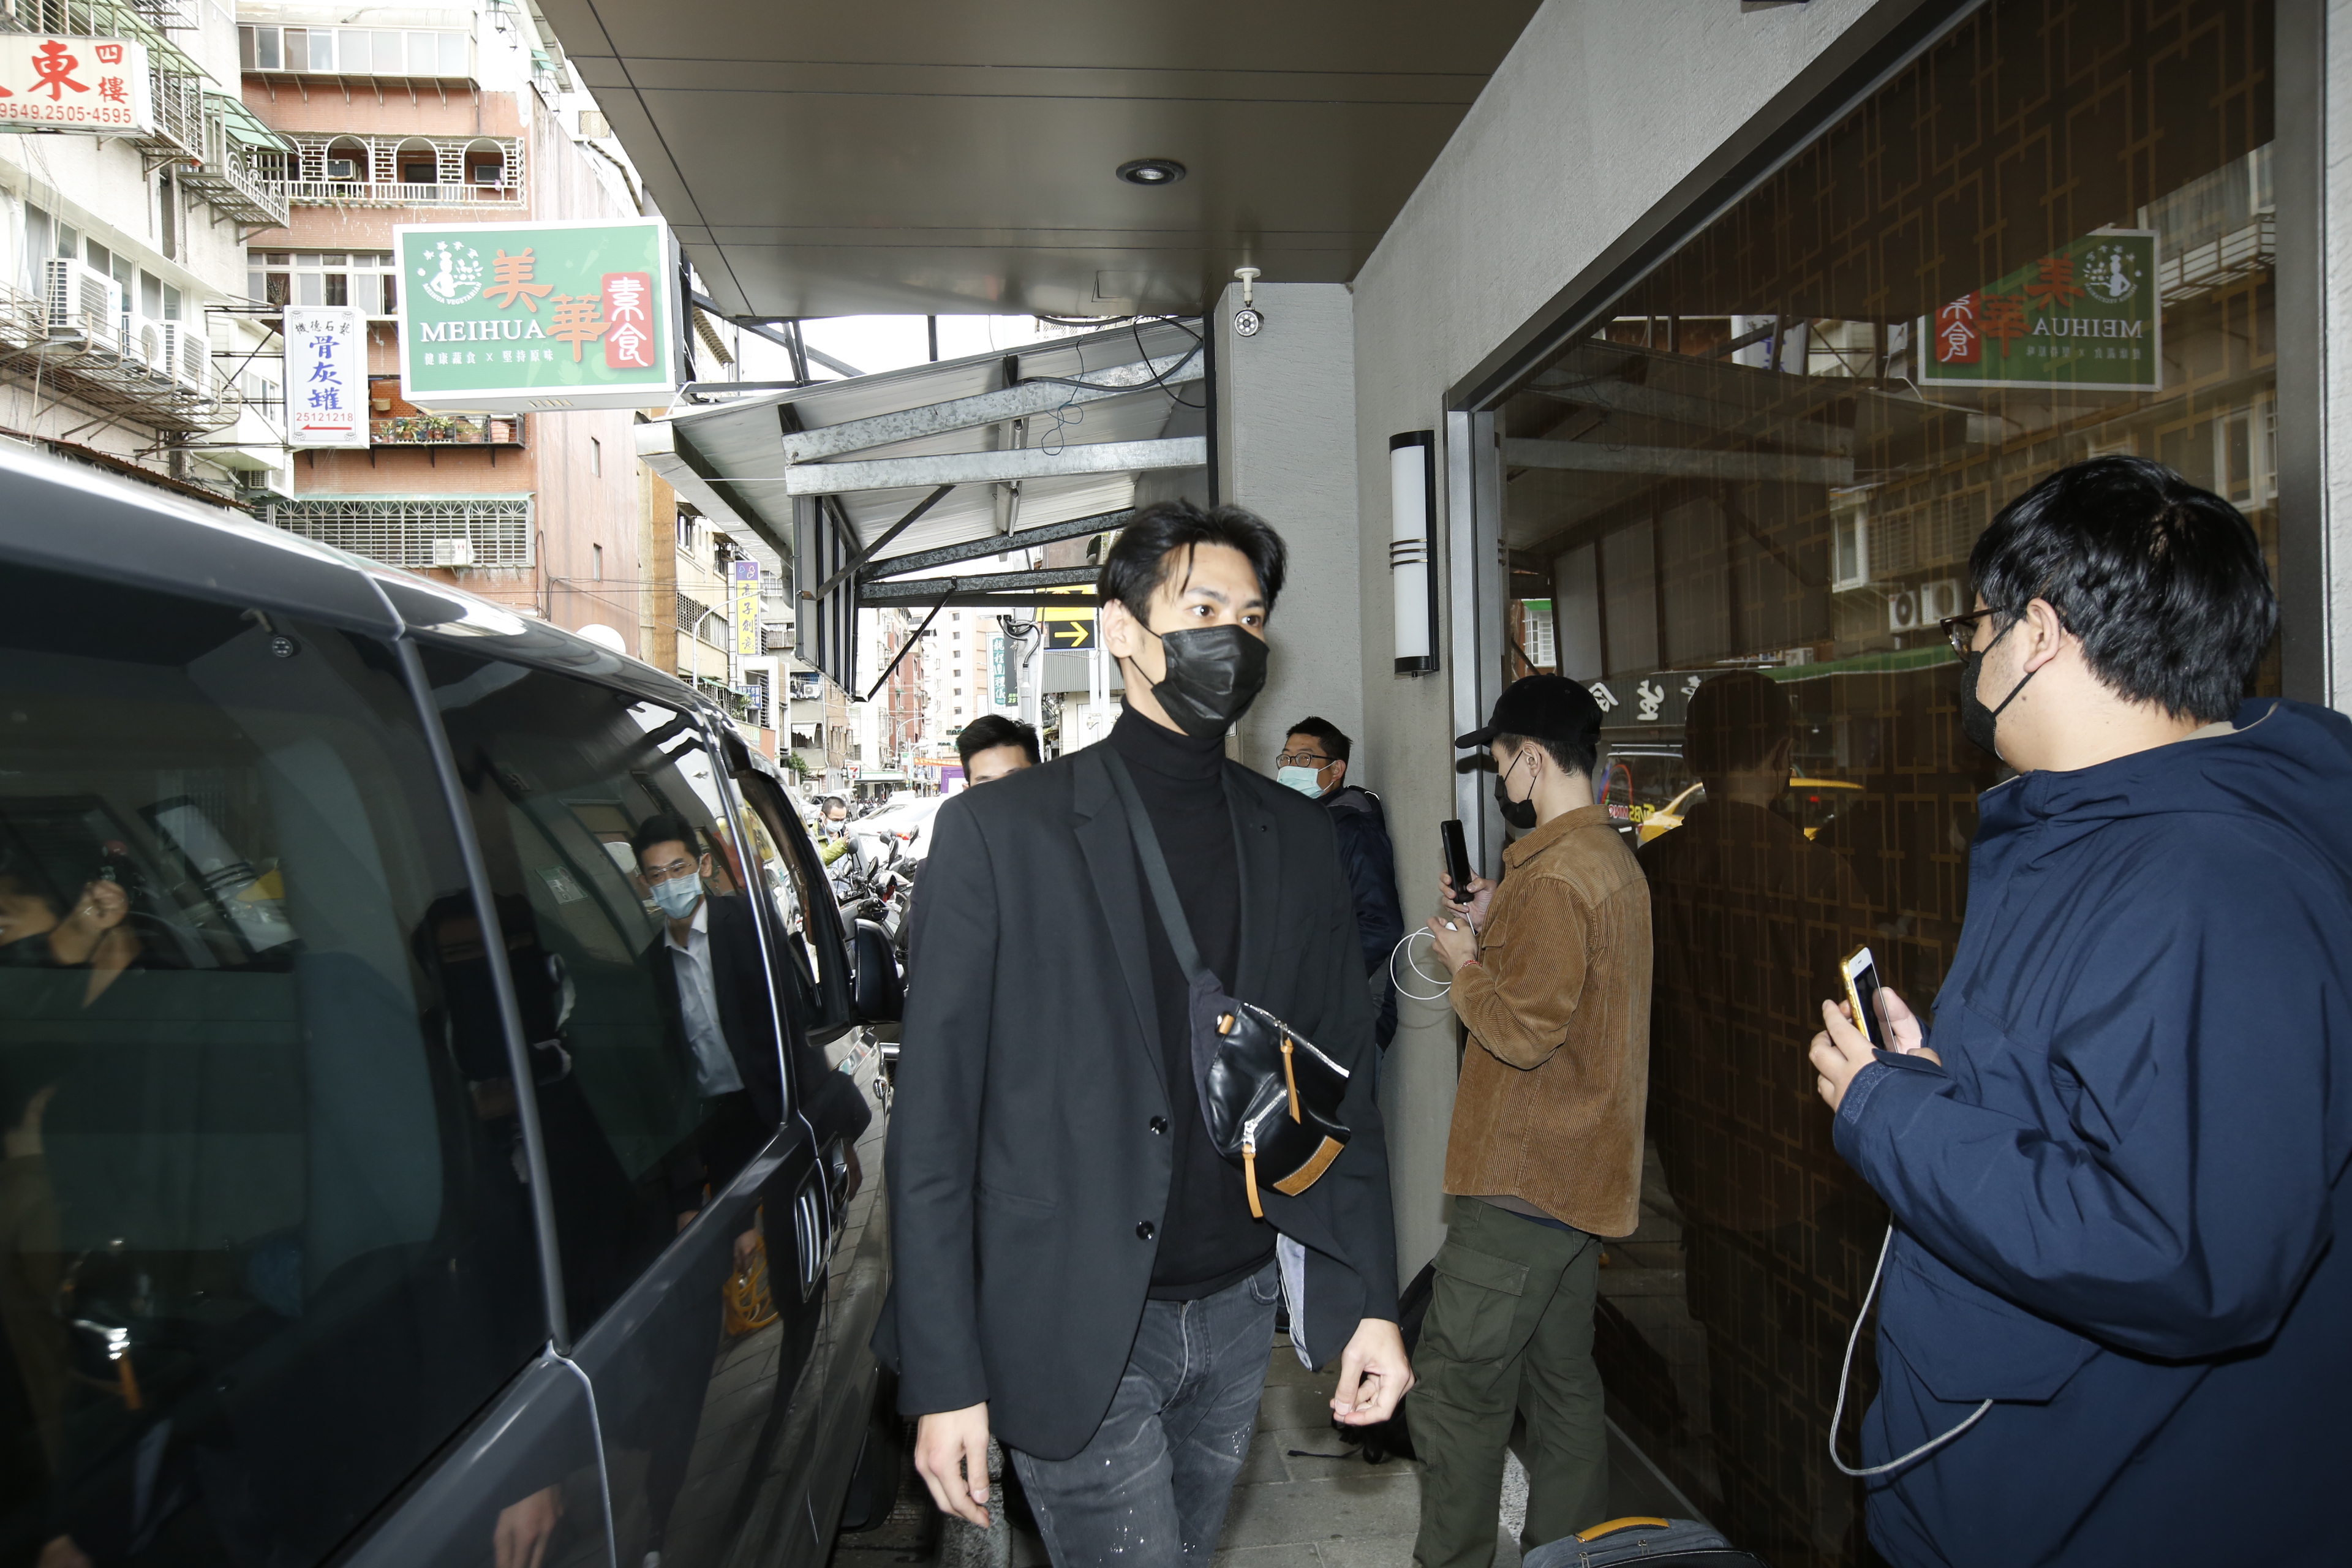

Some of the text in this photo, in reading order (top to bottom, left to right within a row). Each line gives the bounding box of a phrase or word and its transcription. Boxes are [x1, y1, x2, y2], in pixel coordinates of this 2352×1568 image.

[0, 40, 90, 102] 東
[95, 44, 129, 104] 四樓
[0, 102, 131, 123] 9549.2505-4595
[422, 282, 483, 305] MEIHUA VEGETARIAN
[483, 247, 612, 363] 美華
[419, 319, 546, 342] MEIHUA
[608, 276, 649, 367] 素食
[306, 335, 343, 411] 骨灰罐
[424, 352, 476, 366] 健康蔬食
[502, 349, 554, 363] 堅持原味
[296, 412, 353, 421] 25121218
